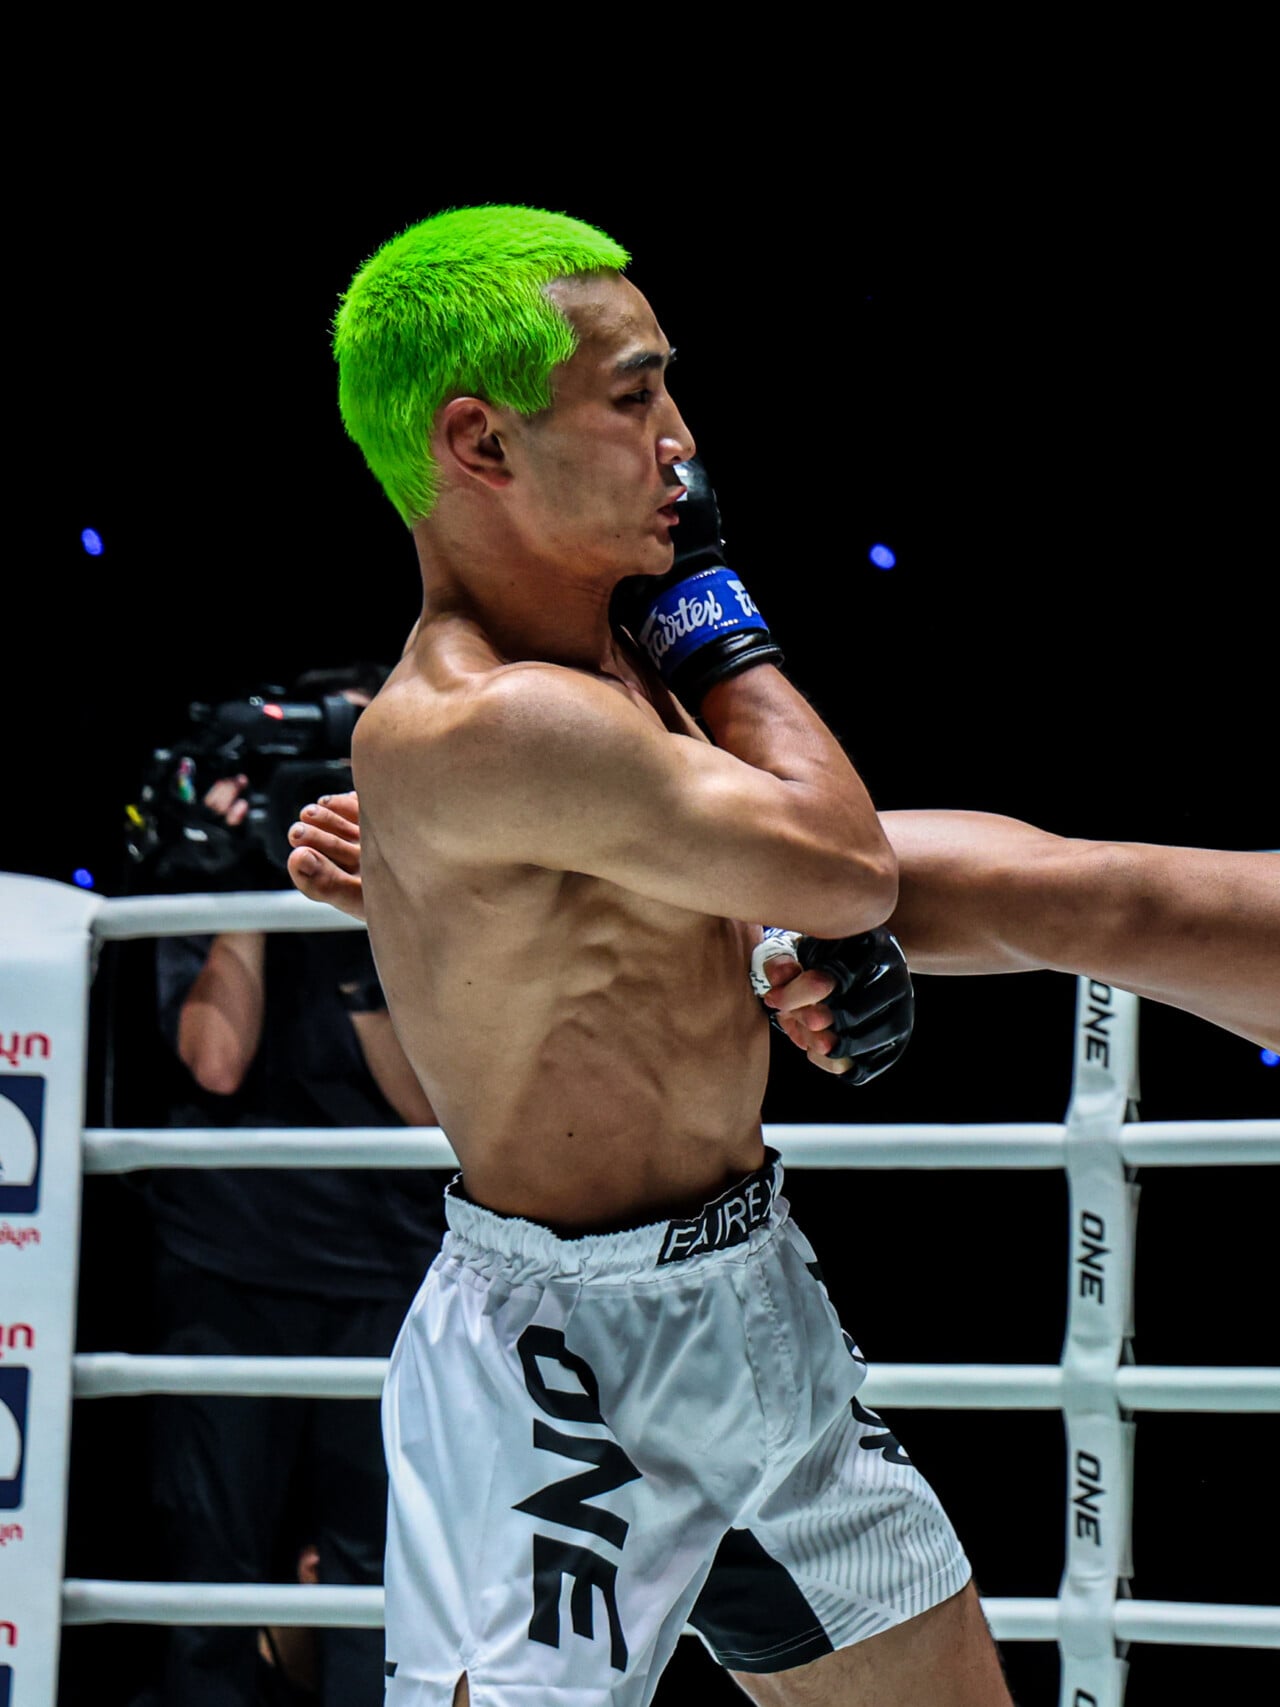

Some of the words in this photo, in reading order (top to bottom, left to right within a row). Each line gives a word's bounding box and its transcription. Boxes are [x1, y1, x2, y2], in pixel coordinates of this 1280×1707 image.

[1084, 979, 1115, 1068] ONE
[1077, 1210, 1110, 1305] ONE
[511, 1324, 643, 1672] ONE
[1073, 1450, 1105, 1547] ONE
